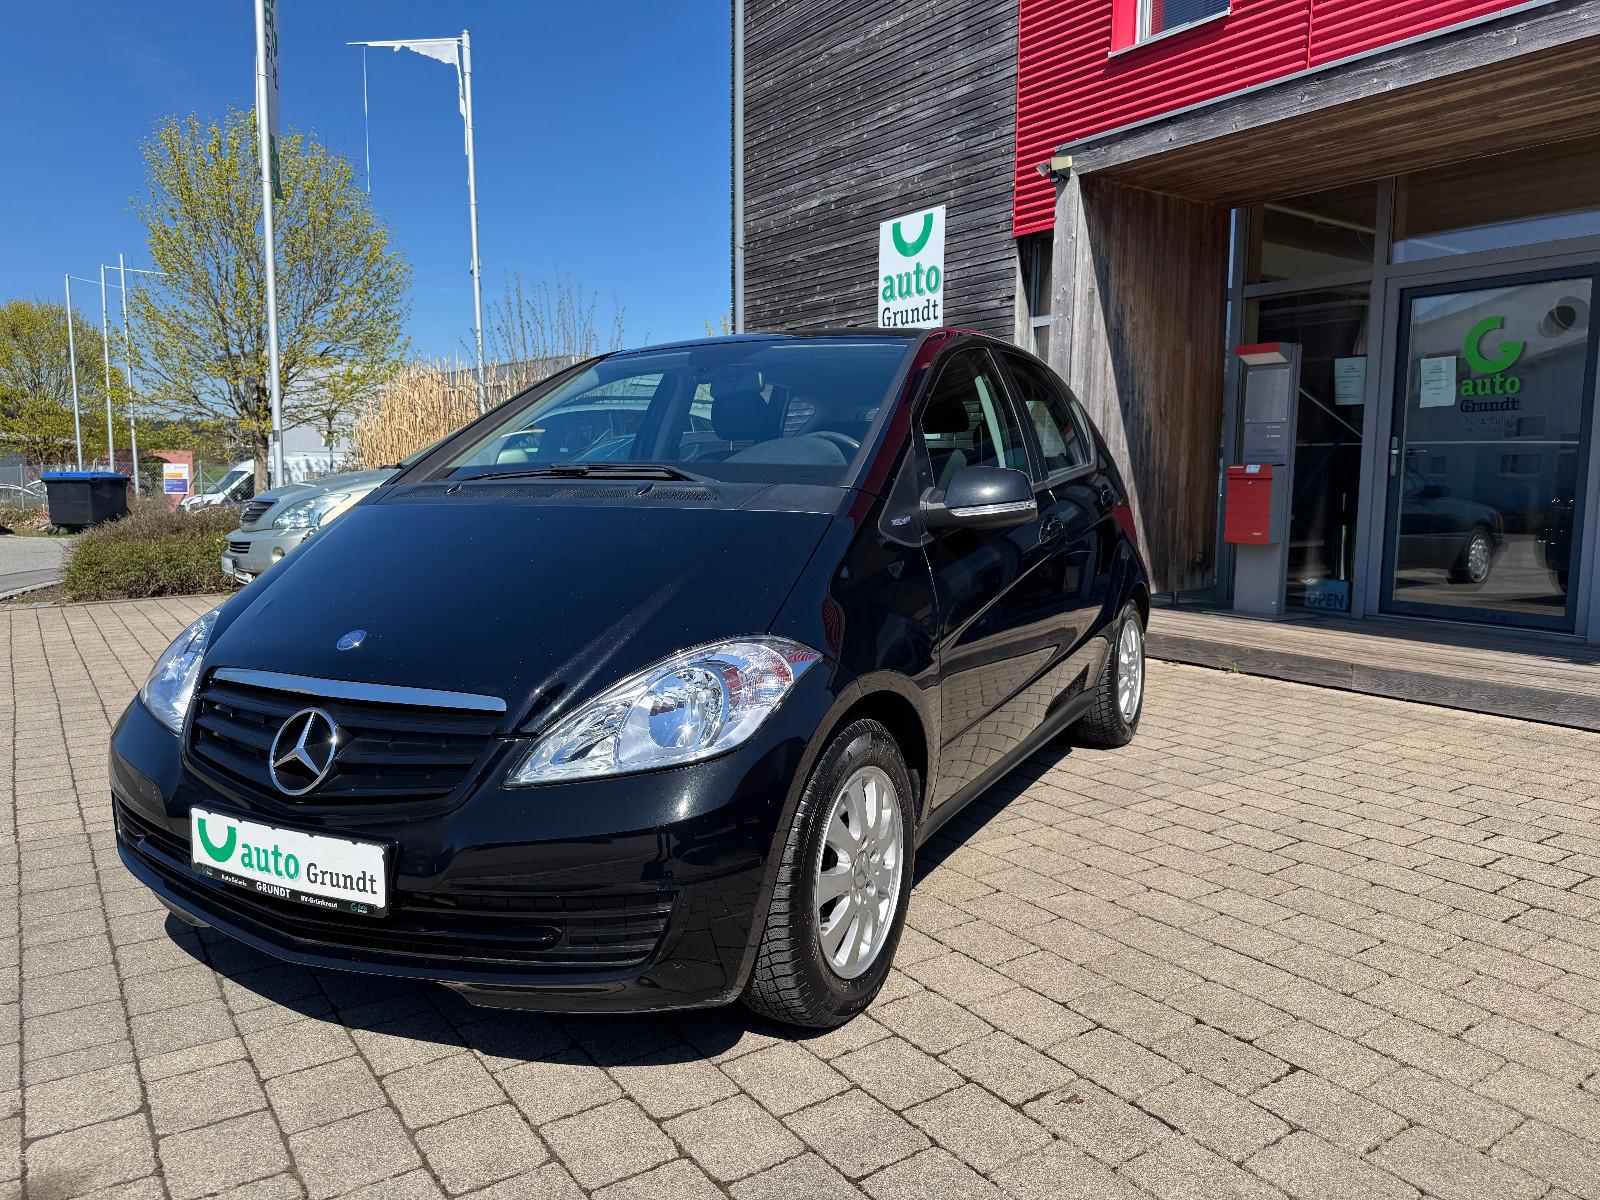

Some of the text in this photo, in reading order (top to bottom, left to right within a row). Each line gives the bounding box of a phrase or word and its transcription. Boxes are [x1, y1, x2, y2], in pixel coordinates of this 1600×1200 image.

[882, 261, 941, 302] auto
[882, 299, 939, 327] Grundt
[1460, 374, 1521, 396] auto
[1460, 397, 1521, 413] Grundt
[1307, 591, 1345, 609] OPEN
[240, 843, 378, 895] auto Grundt
[256, 881, 291, 898] GRUNDT
